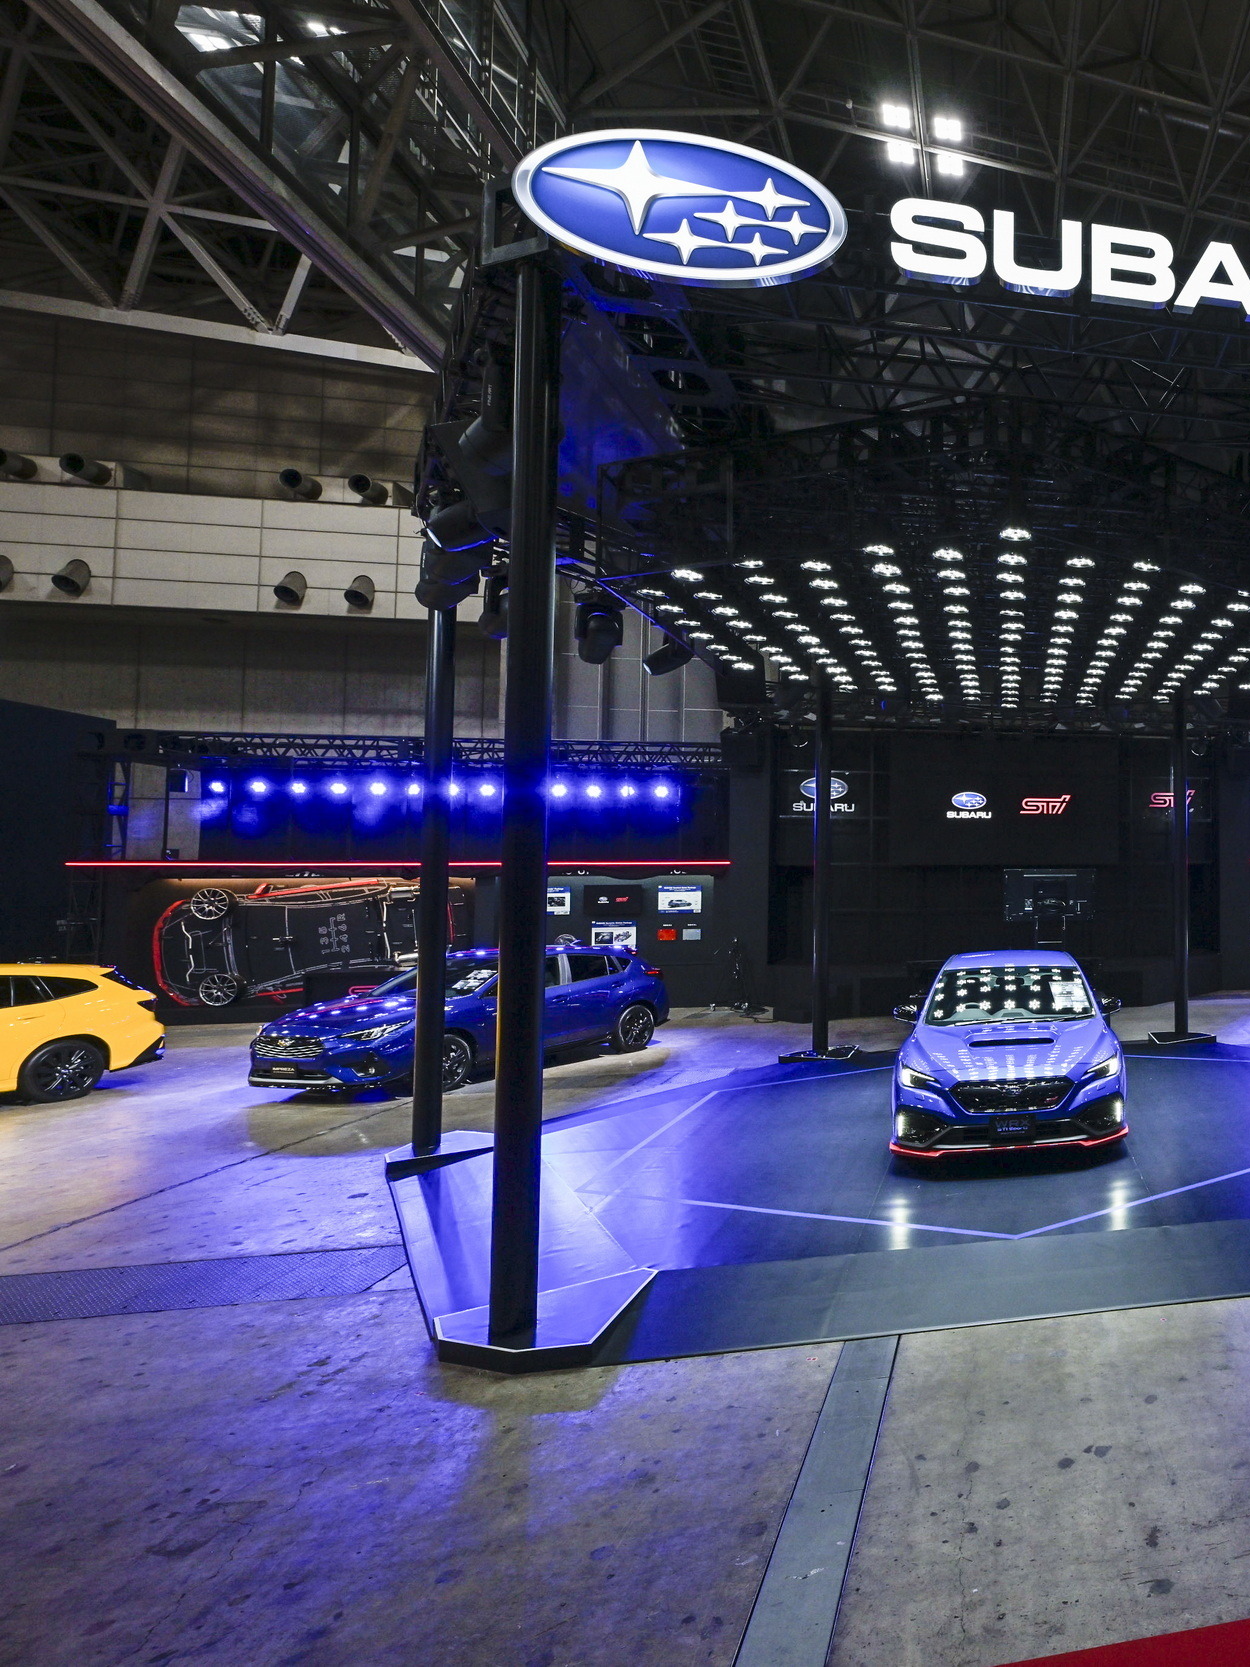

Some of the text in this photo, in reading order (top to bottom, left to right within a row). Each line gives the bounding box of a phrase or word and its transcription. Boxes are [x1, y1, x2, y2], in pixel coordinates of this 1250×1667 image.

[792, 802, 855, 812] SURU
[946, 811, 991, 819] SUBARU
[995, 1119, 1030, 1129] WRX
